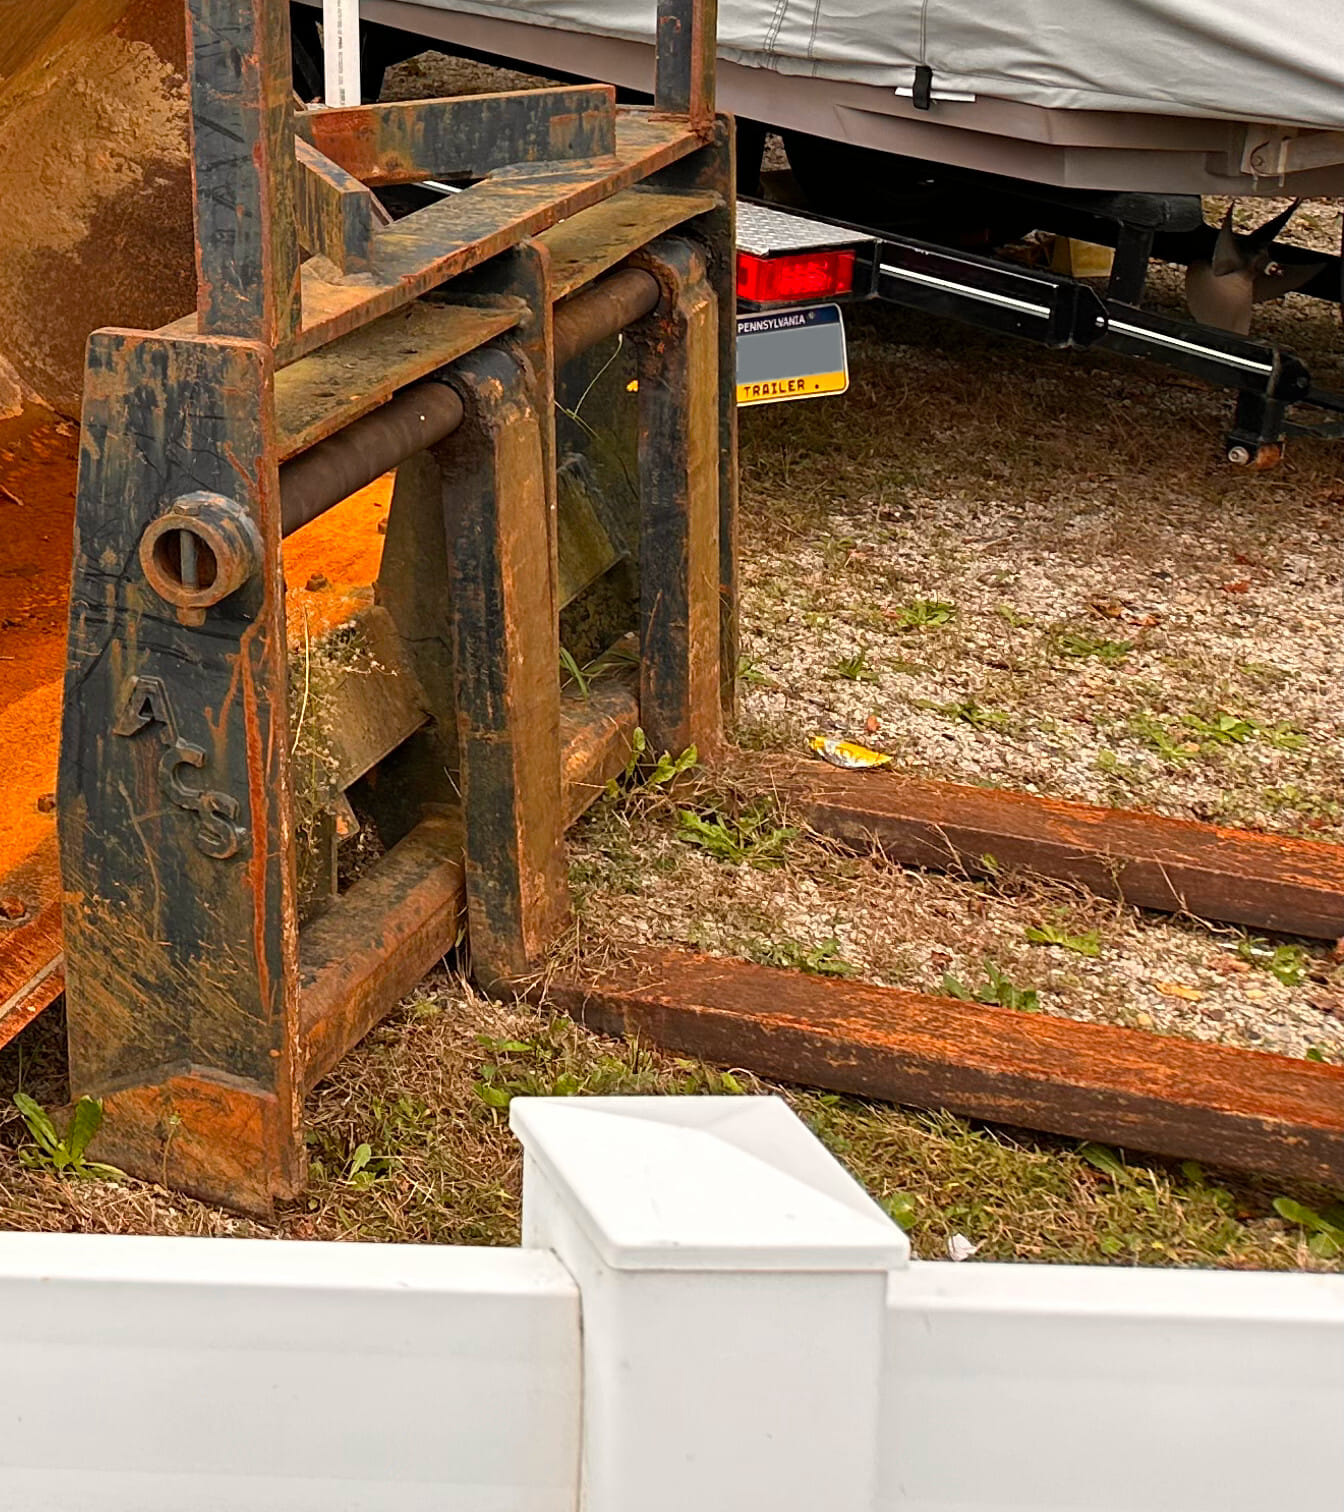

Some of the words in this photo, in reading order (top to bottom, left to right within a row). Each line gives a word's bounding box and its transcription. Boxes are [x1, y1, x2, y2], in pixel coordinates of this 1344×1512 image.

[737, 314, 806, 334] PENNSYLVANIA
[743, 379, 805, 398] TRAILER
[113, 675, 240, 859] ACS
